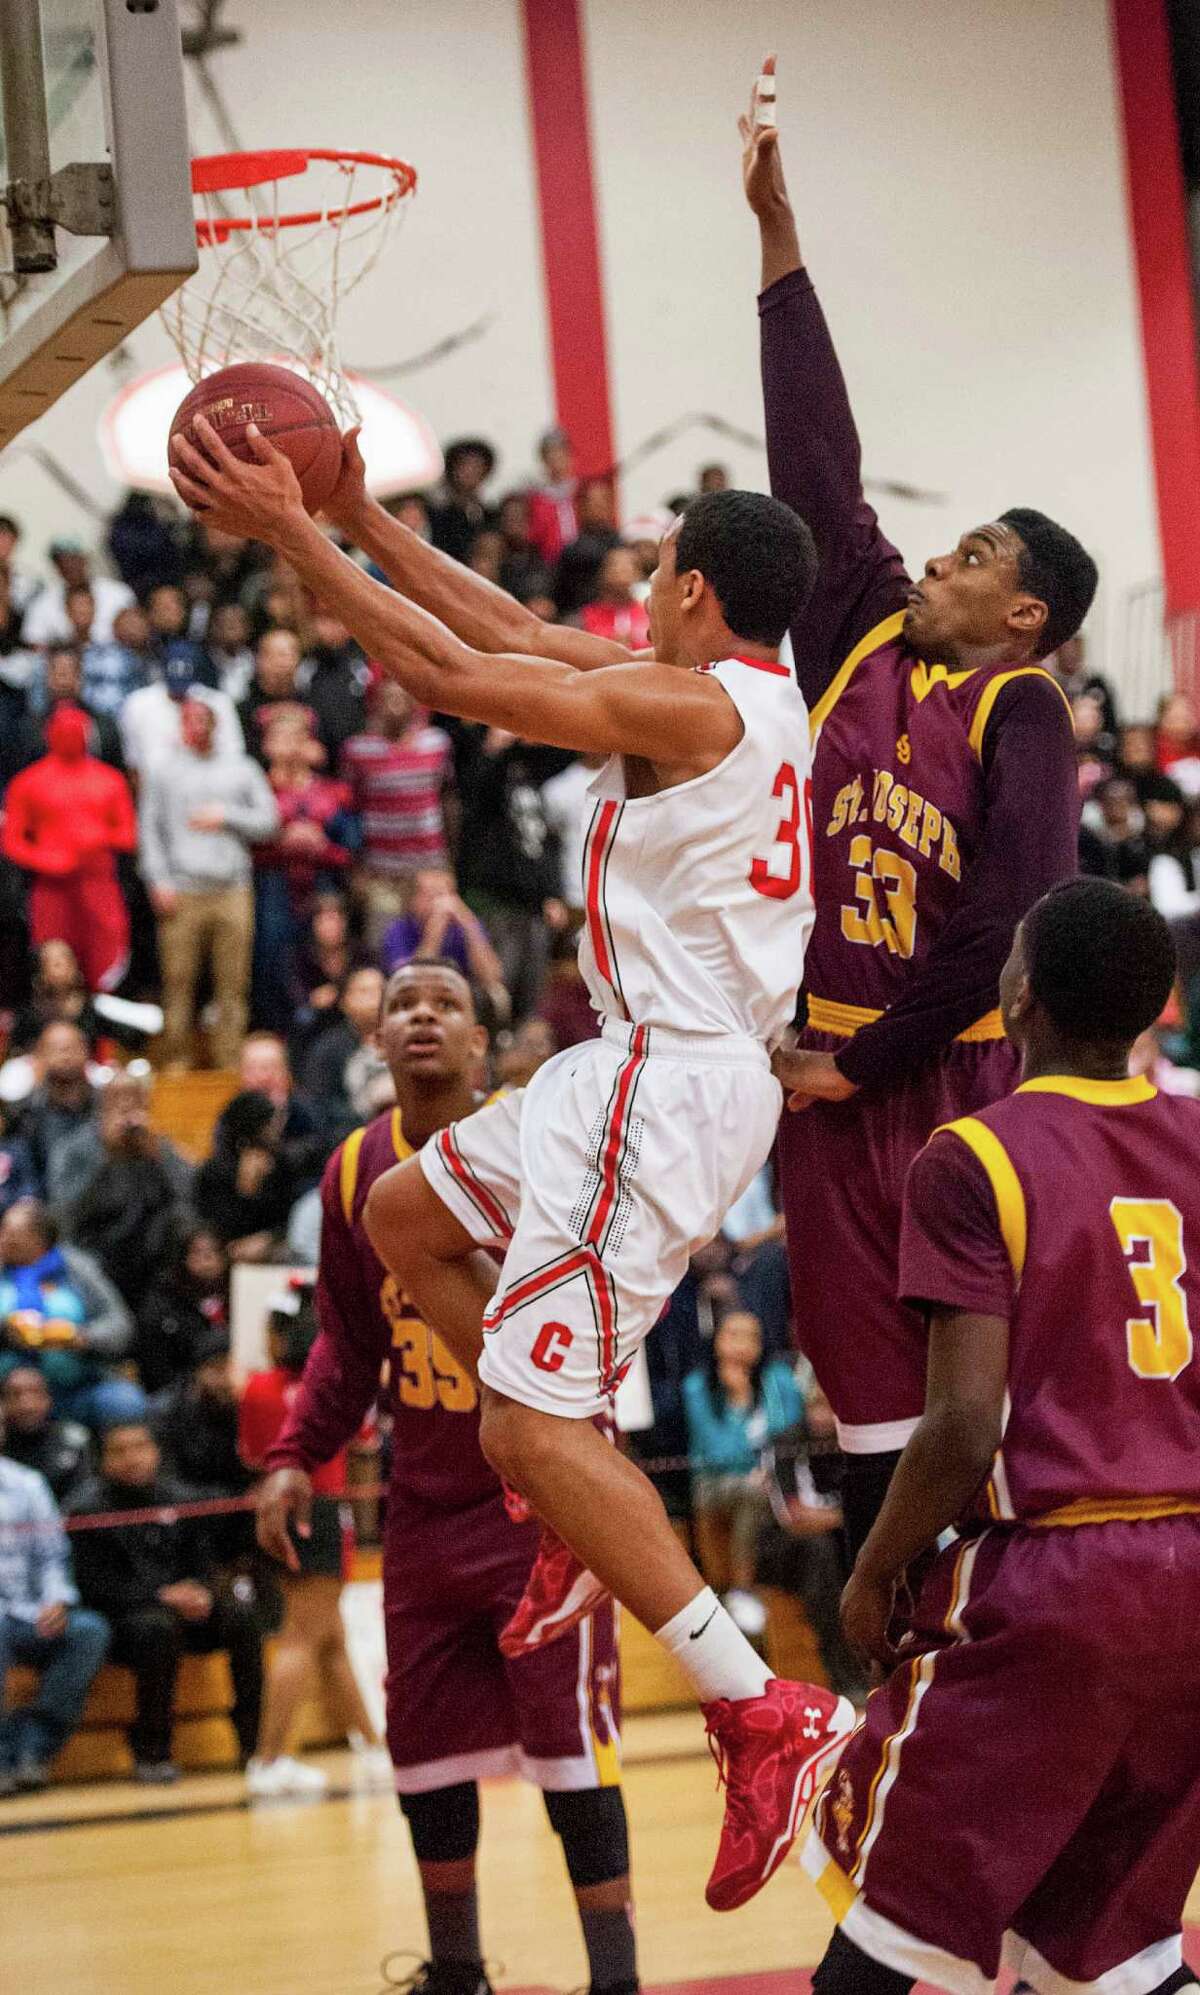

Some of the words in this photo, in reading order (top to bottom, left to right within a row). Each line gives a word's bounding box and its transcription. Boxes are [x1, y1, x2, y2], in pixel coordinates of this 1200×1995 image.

[748, 761, 815, 901] 3
[841, 834, 918, 960] 33
[530, 1321, 574, 1373] C
[1109, 1196, 1194, 1382] 3
[391, 1317, 478, 1413] 35
